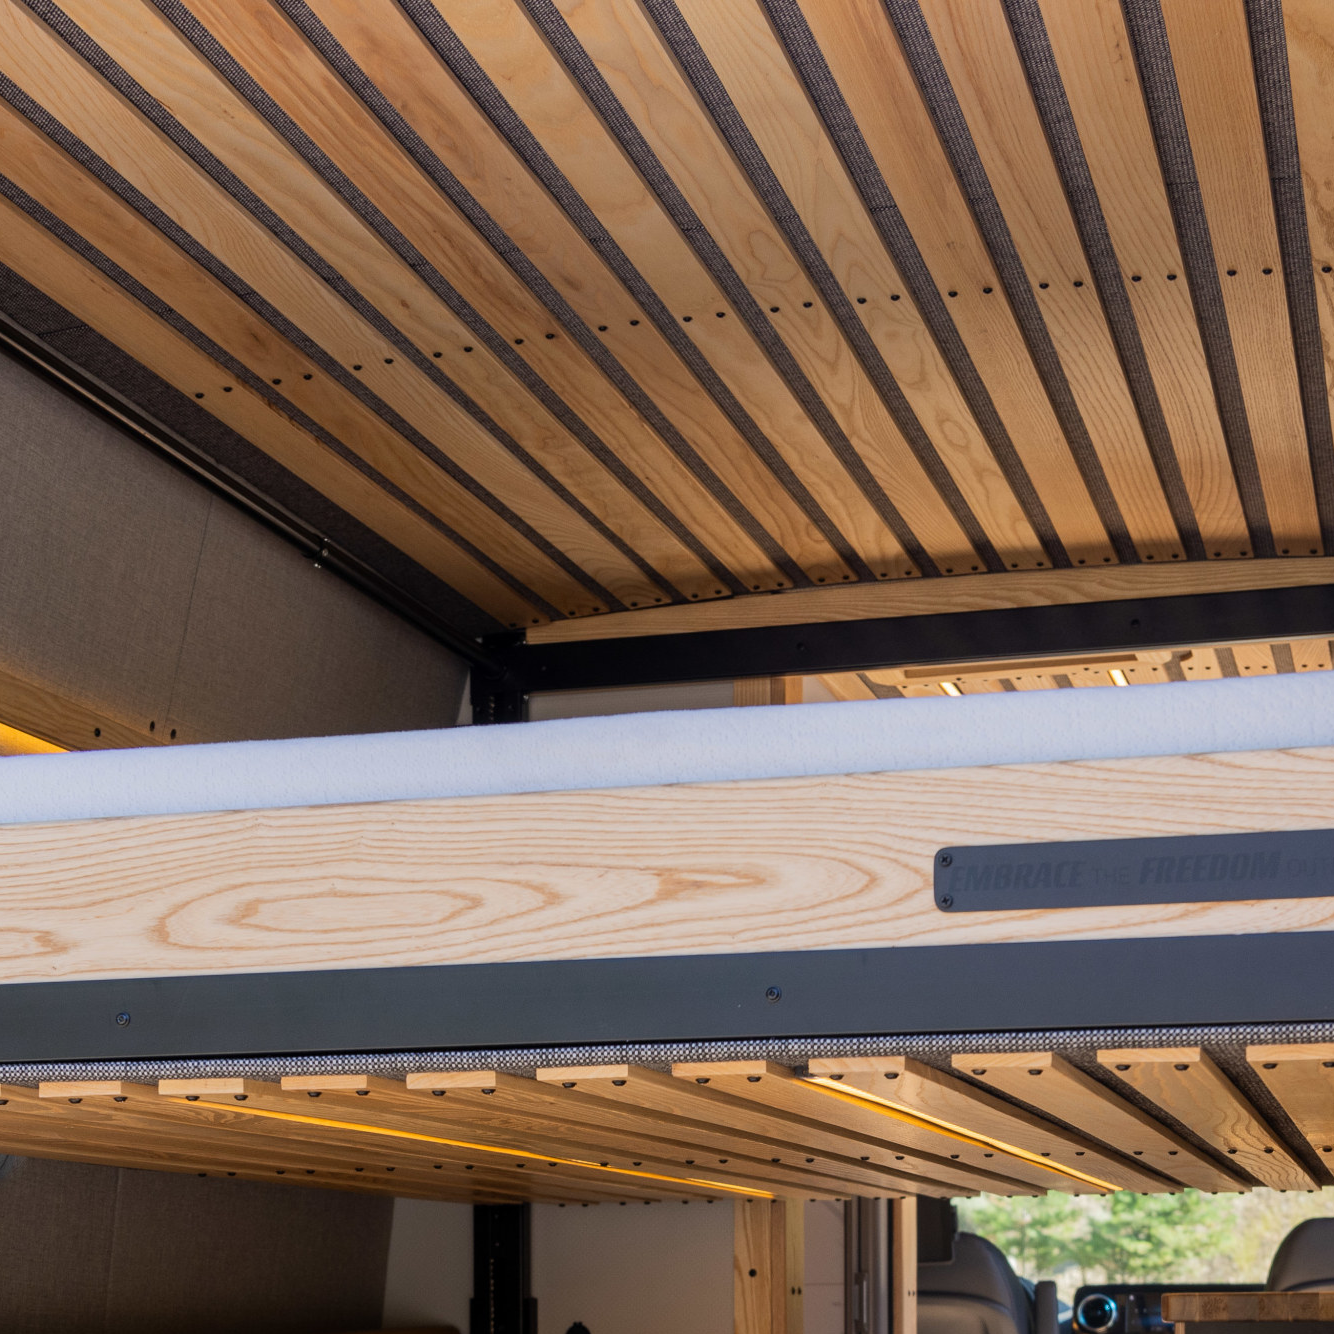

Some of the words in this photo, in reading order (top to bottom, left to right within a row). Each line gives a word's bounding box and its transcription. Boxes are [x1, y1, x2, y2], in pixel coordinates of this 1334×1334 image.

[947, 860, 1087, 892] EMBRACE
[1094, 865, 1130, 885] THE
[1139, 851, 1282, 884] FREEDOM
